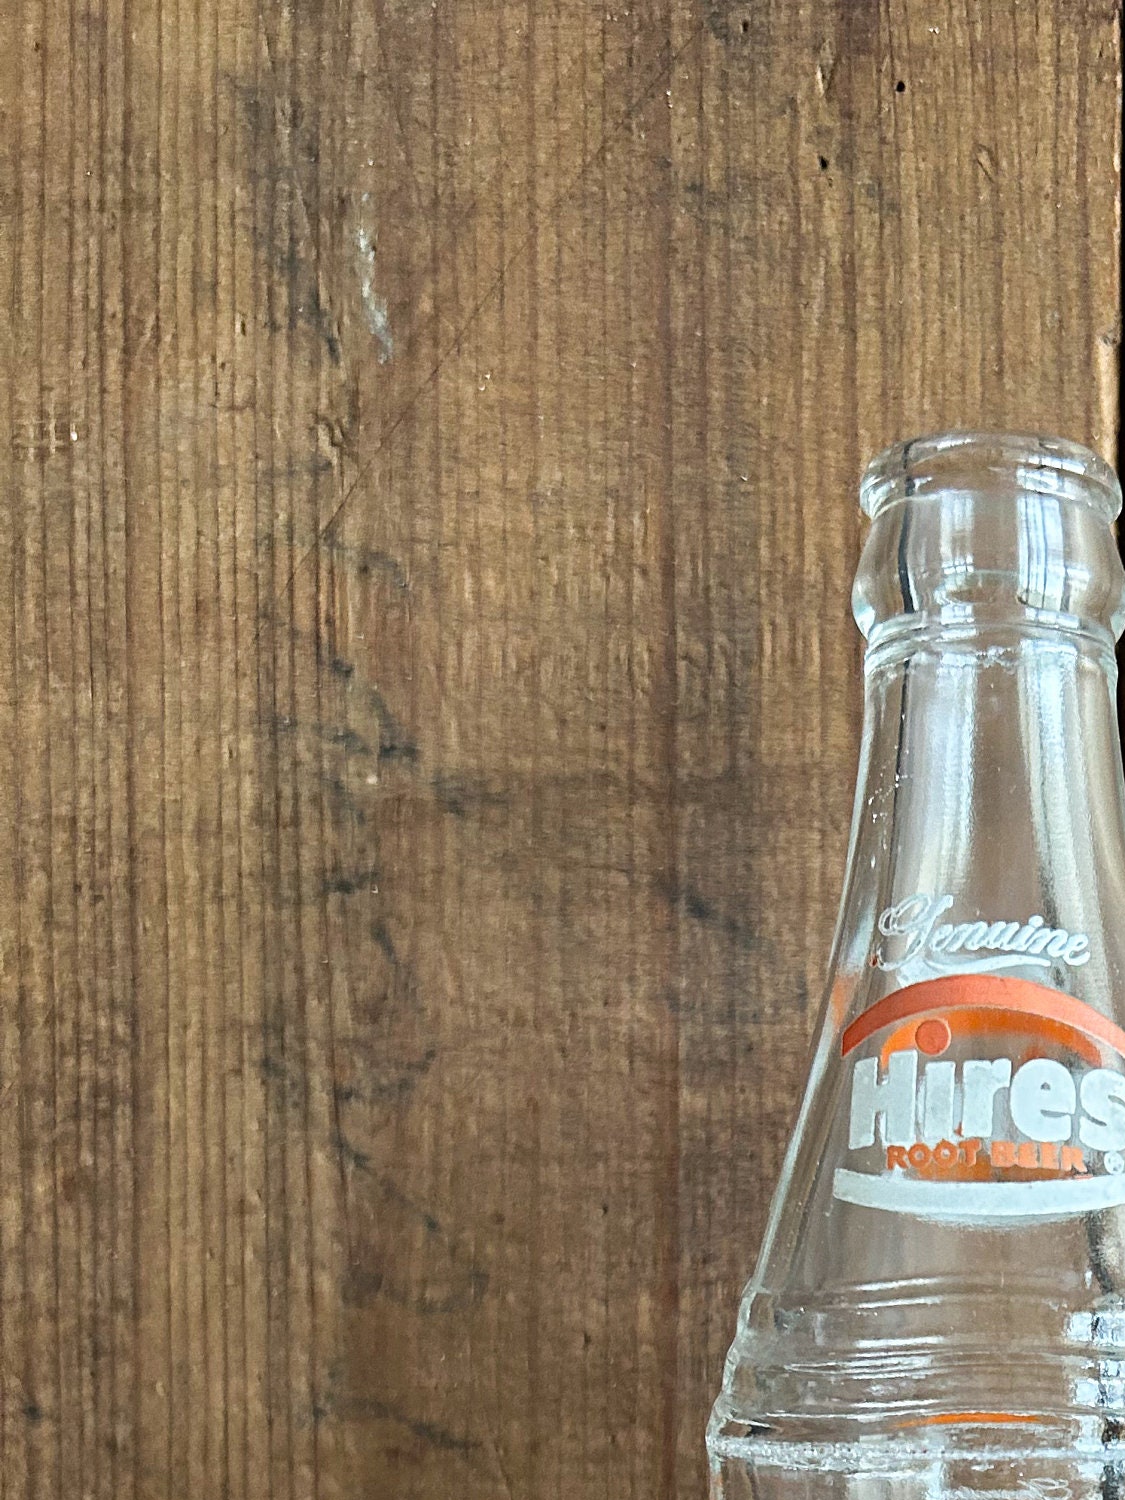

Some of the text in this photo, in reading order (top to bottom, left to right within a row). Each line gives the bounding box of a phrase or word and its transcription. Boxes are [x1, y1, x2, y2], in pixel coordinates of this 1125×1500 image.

[875, 894, 1091, 972] Genuine
[886, 1138, 1089, 1174] ROOT BEER
